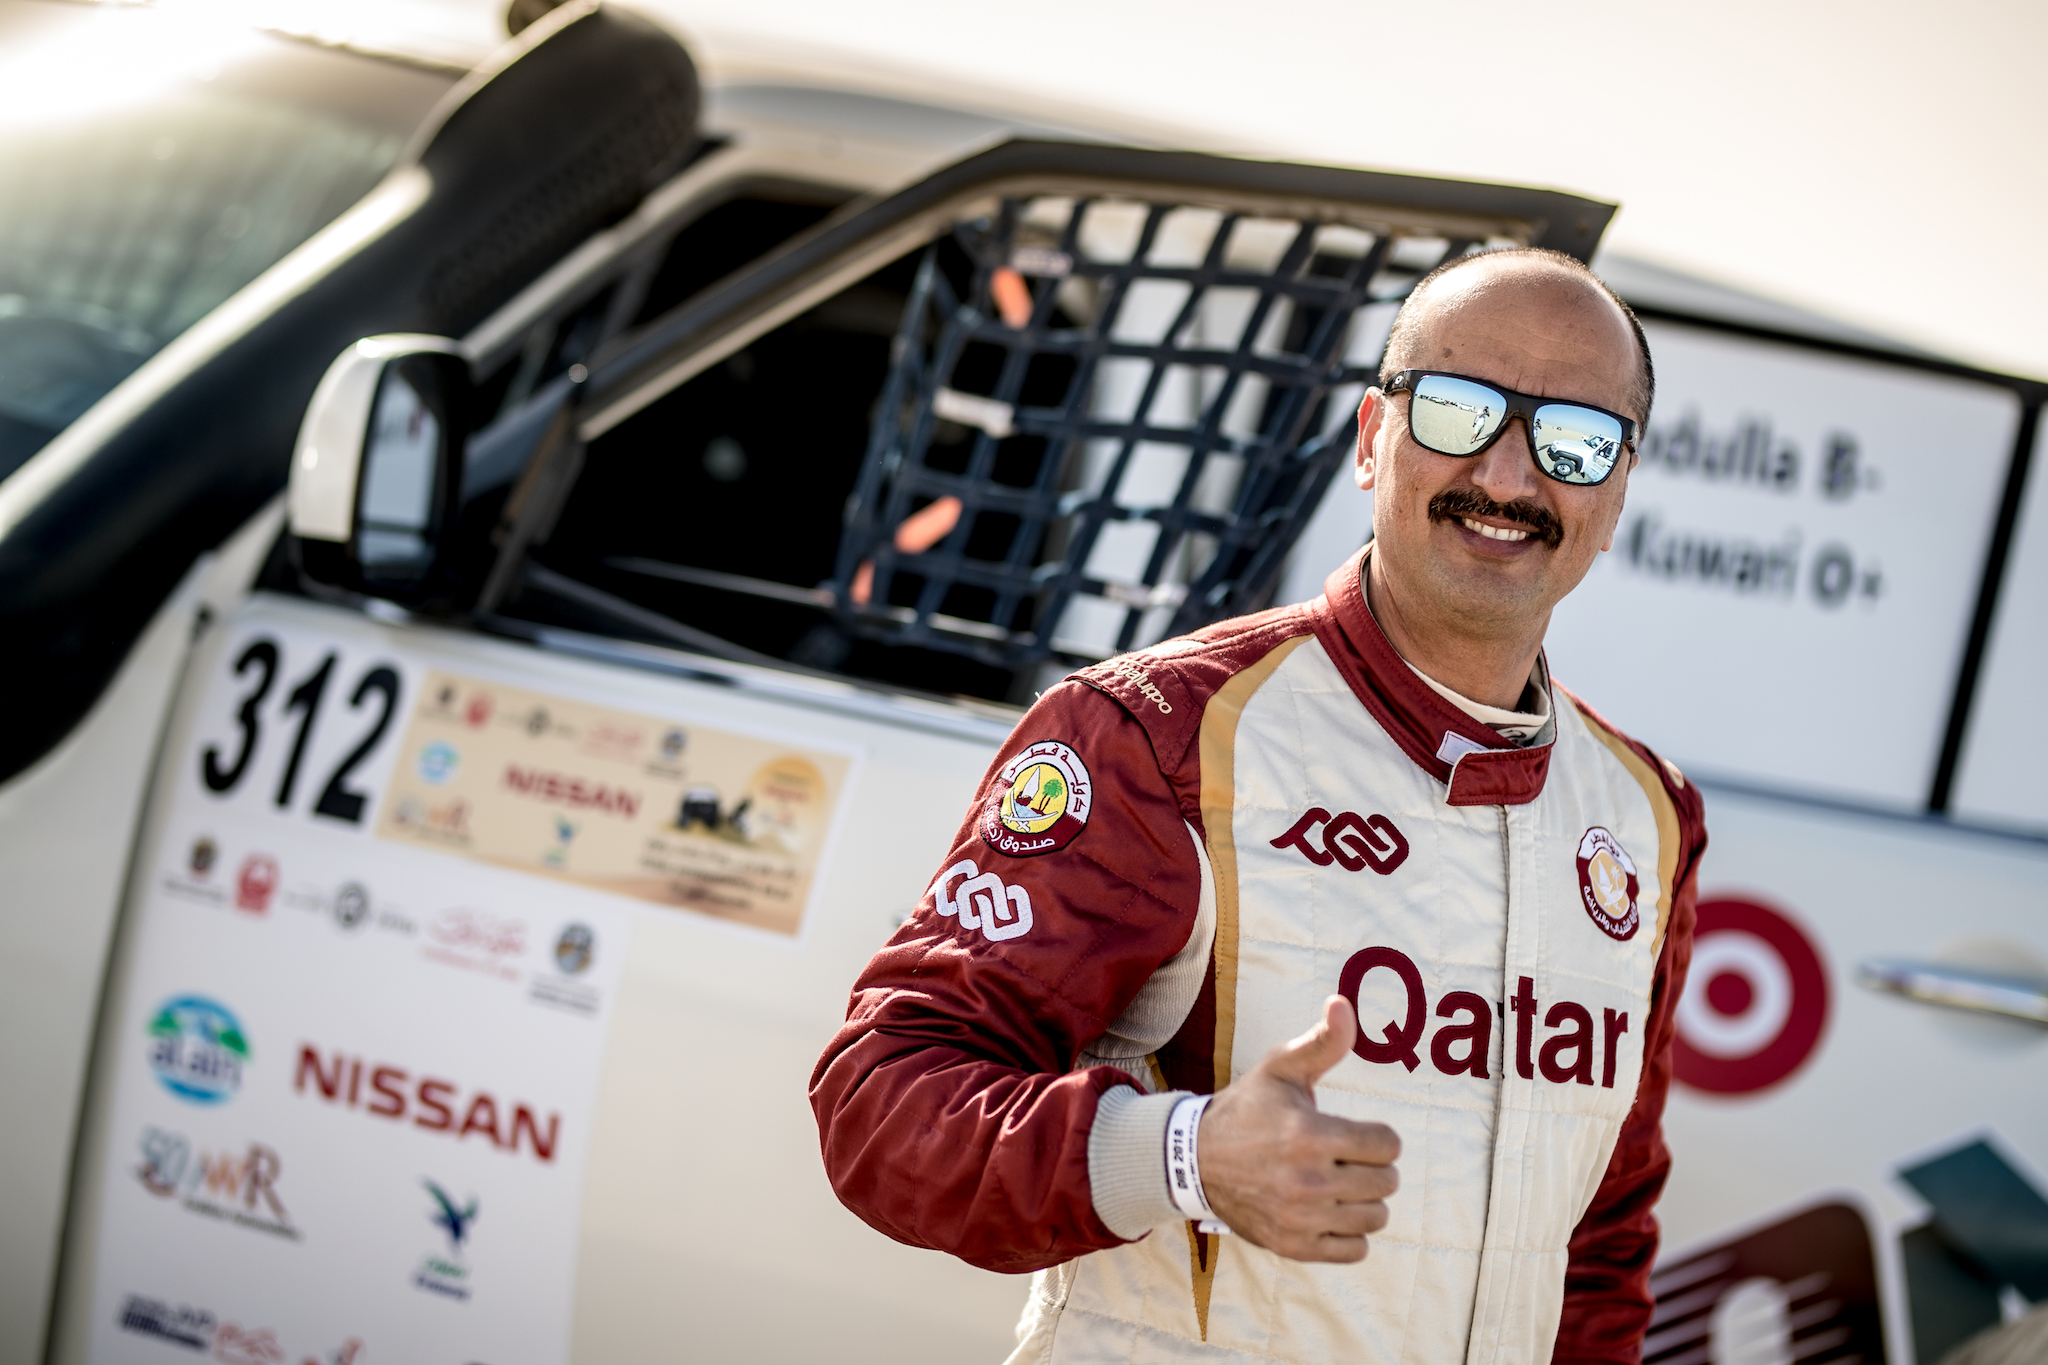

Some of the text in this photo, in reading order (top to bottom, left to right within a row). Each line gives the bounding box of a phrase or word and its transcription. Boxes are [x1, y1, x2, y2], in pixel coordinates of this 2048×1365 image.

[1629, 508, 1801, 597] Kuwari
[202, 634, 402, 826] 312
[505, 763, 640, 820] NISSAN
[1338, 946, 1629, 1088] Qatar
[296, 1044, 561, 1163] NISSAN
[1173, 1129, 1184, 1162] 2018
